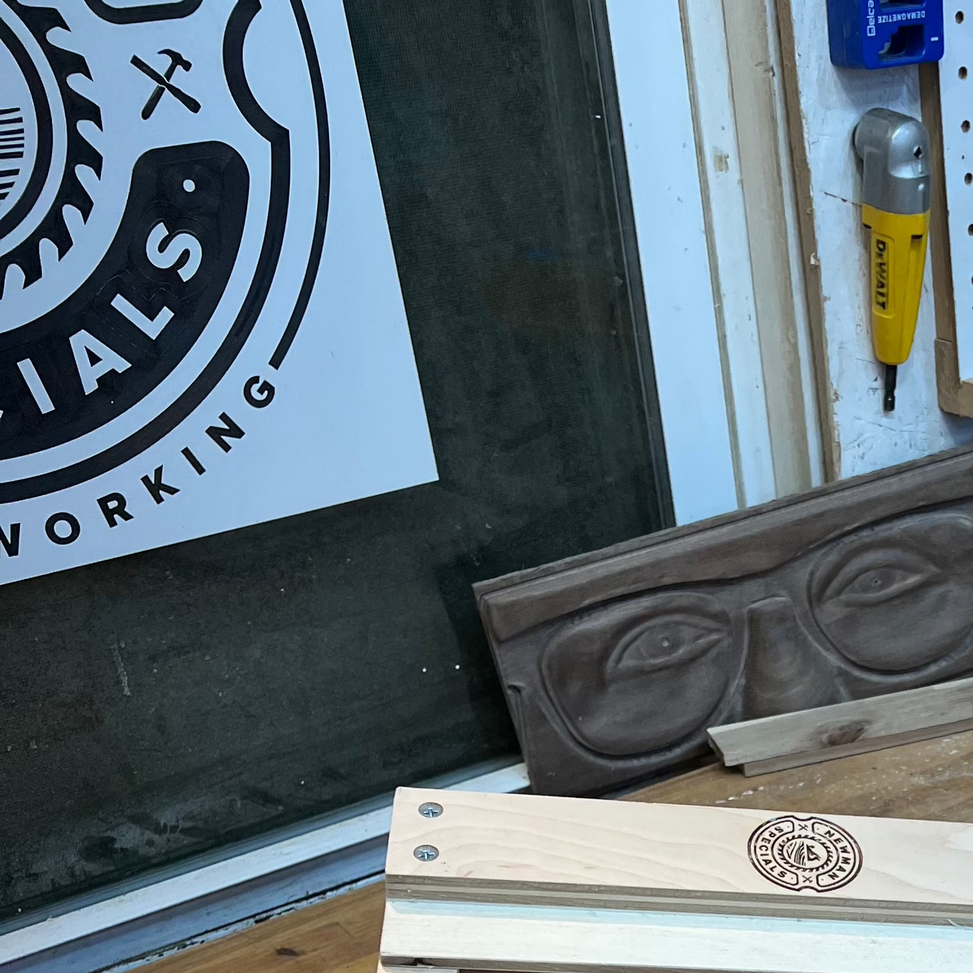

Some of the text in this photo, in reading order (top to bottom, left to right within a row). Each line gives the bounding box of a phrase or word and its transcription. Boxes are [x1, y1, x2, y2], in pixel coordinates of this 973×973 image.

[877, 10, 926, 24] DEMAGNETIZE
[0, 221, 204, 415] IALS
[758, 825, 787, 878] SPECIALS
[823, 830, 851, 881] NEWMAN
